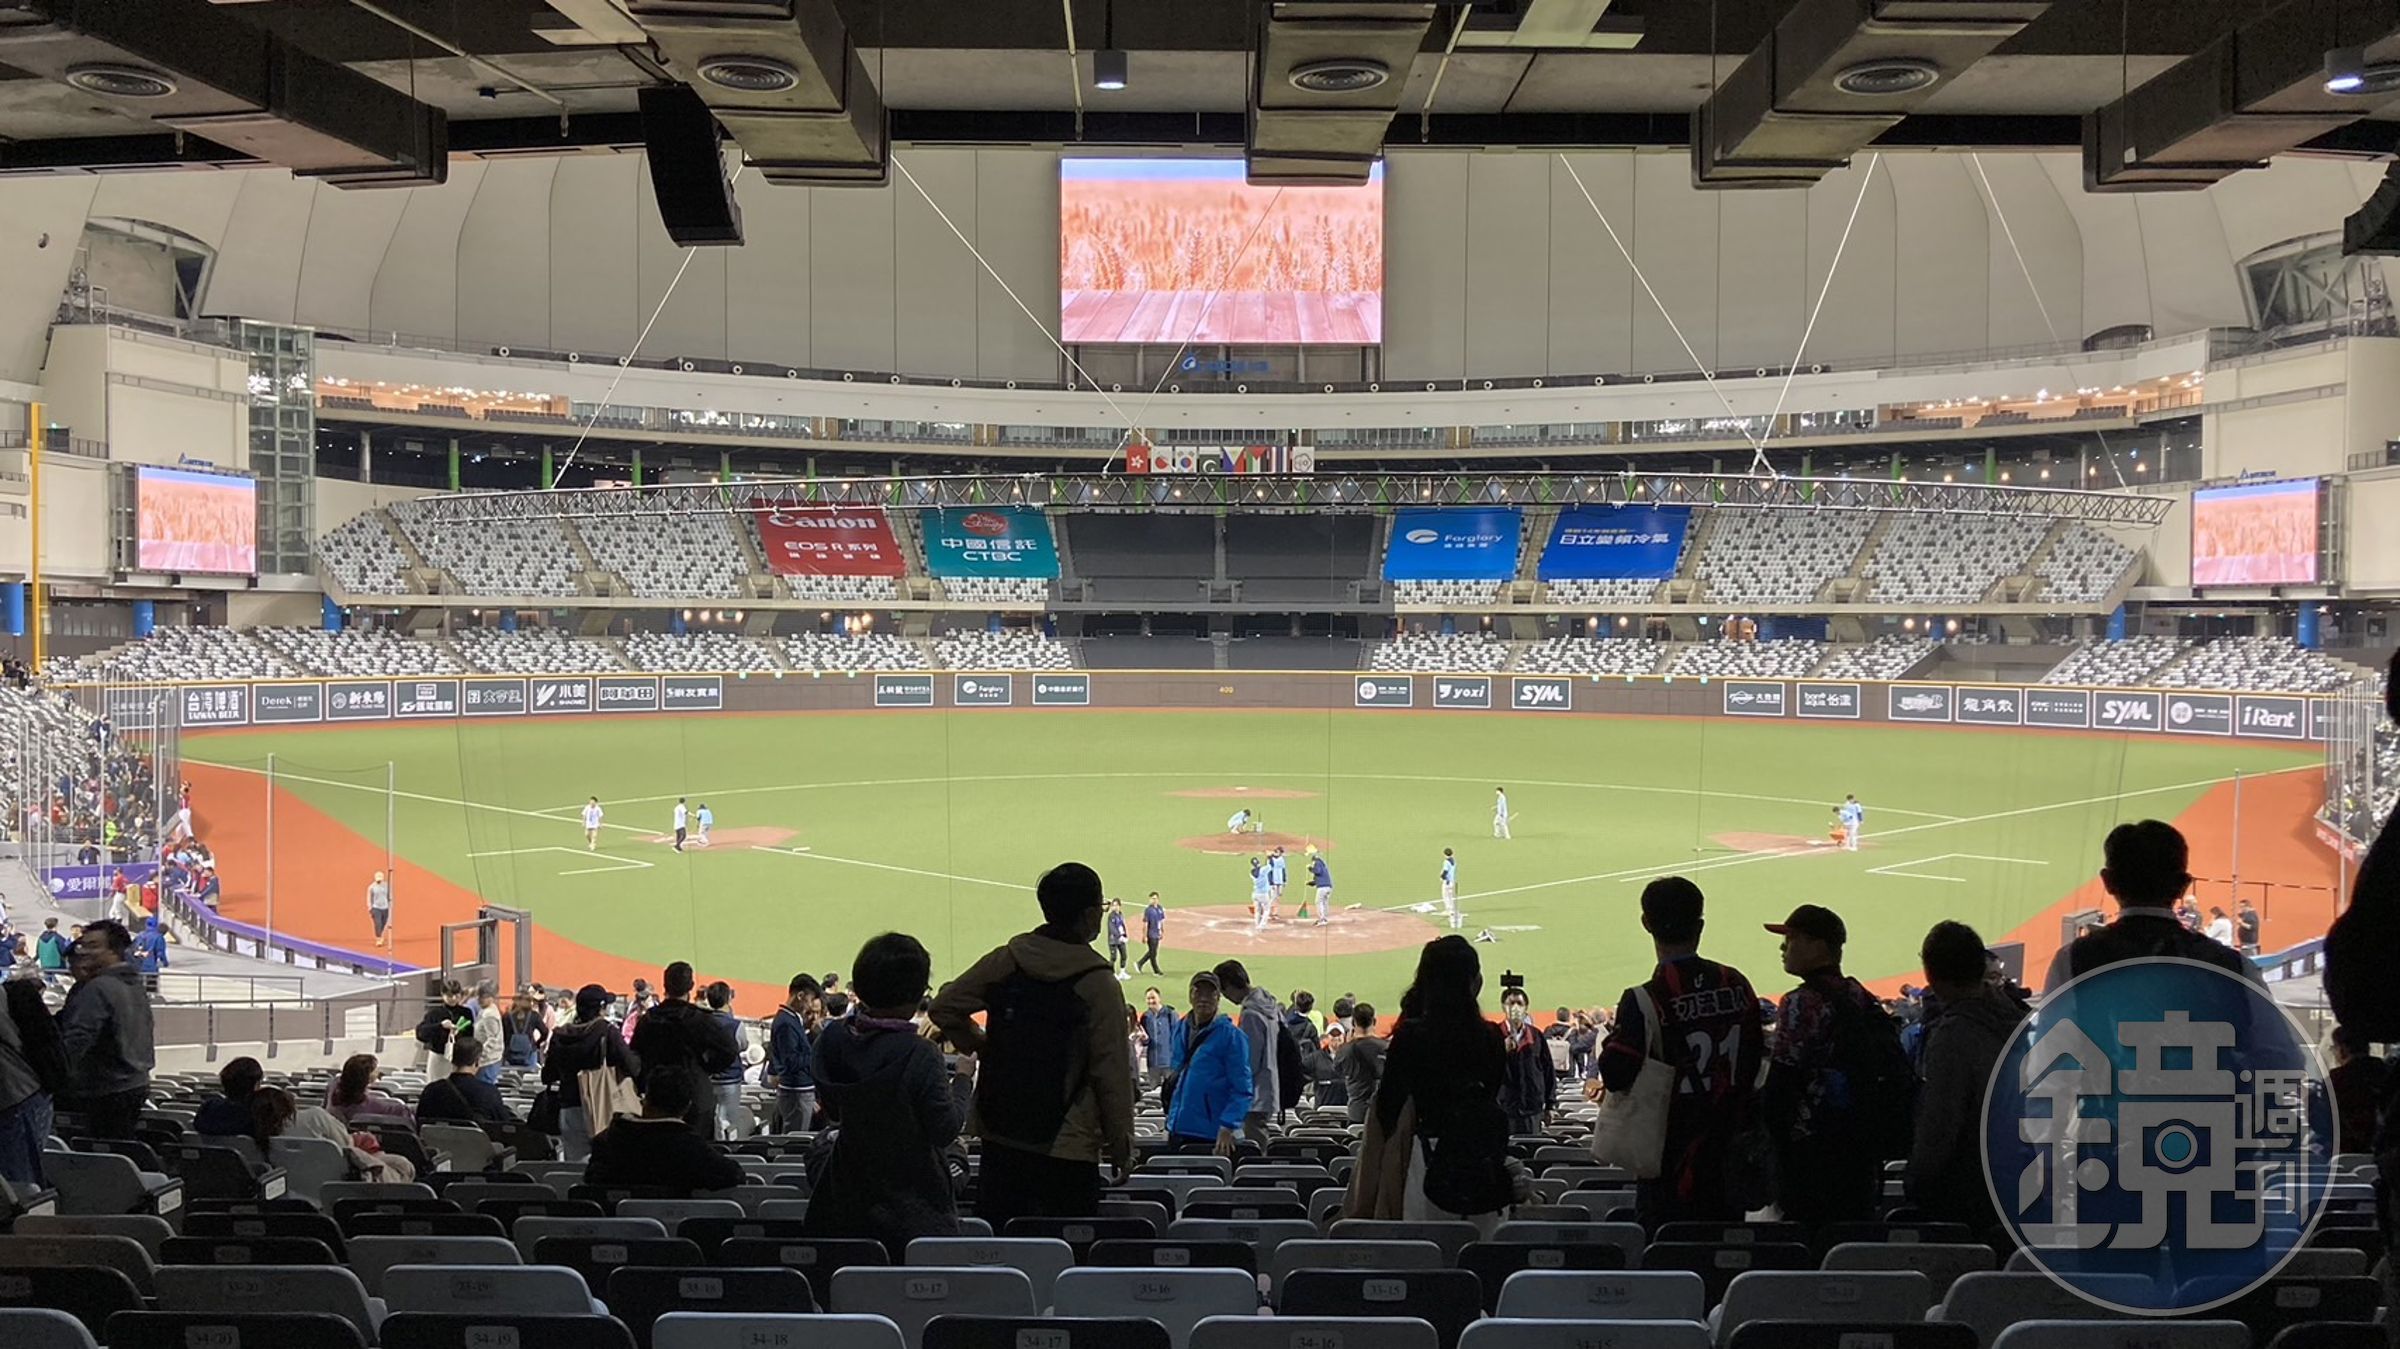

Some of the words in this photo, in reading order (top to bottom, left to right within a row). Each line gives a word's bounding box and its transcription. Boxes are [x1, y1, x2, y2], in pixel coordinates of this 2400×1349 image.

[768, 513, 877, 530] Canon
[942, 537, 1039, 551] 中國信託
[1444, 534, 1504, 544] Farglory
[784, 541, 828, 551] EOS
[831, 542, 844, 551] R
[962, 551, 1023, 562] CTBC
[559, 684, 587, 698] 小美
[1453, 685, 1486, 699] yoxi
[1520, 685, 1564, 705] SYM
[261, 696, 292, 706] Derek
[2102, 701, 2153, 724] SYM
[911, 1282, 943, 1294] 33-17
[750, 1332, 789, 1346] 34-18
[1024, 1335, 1063, 1348] 34-17
[1297, 1336, 1336, 1349] 34-16
